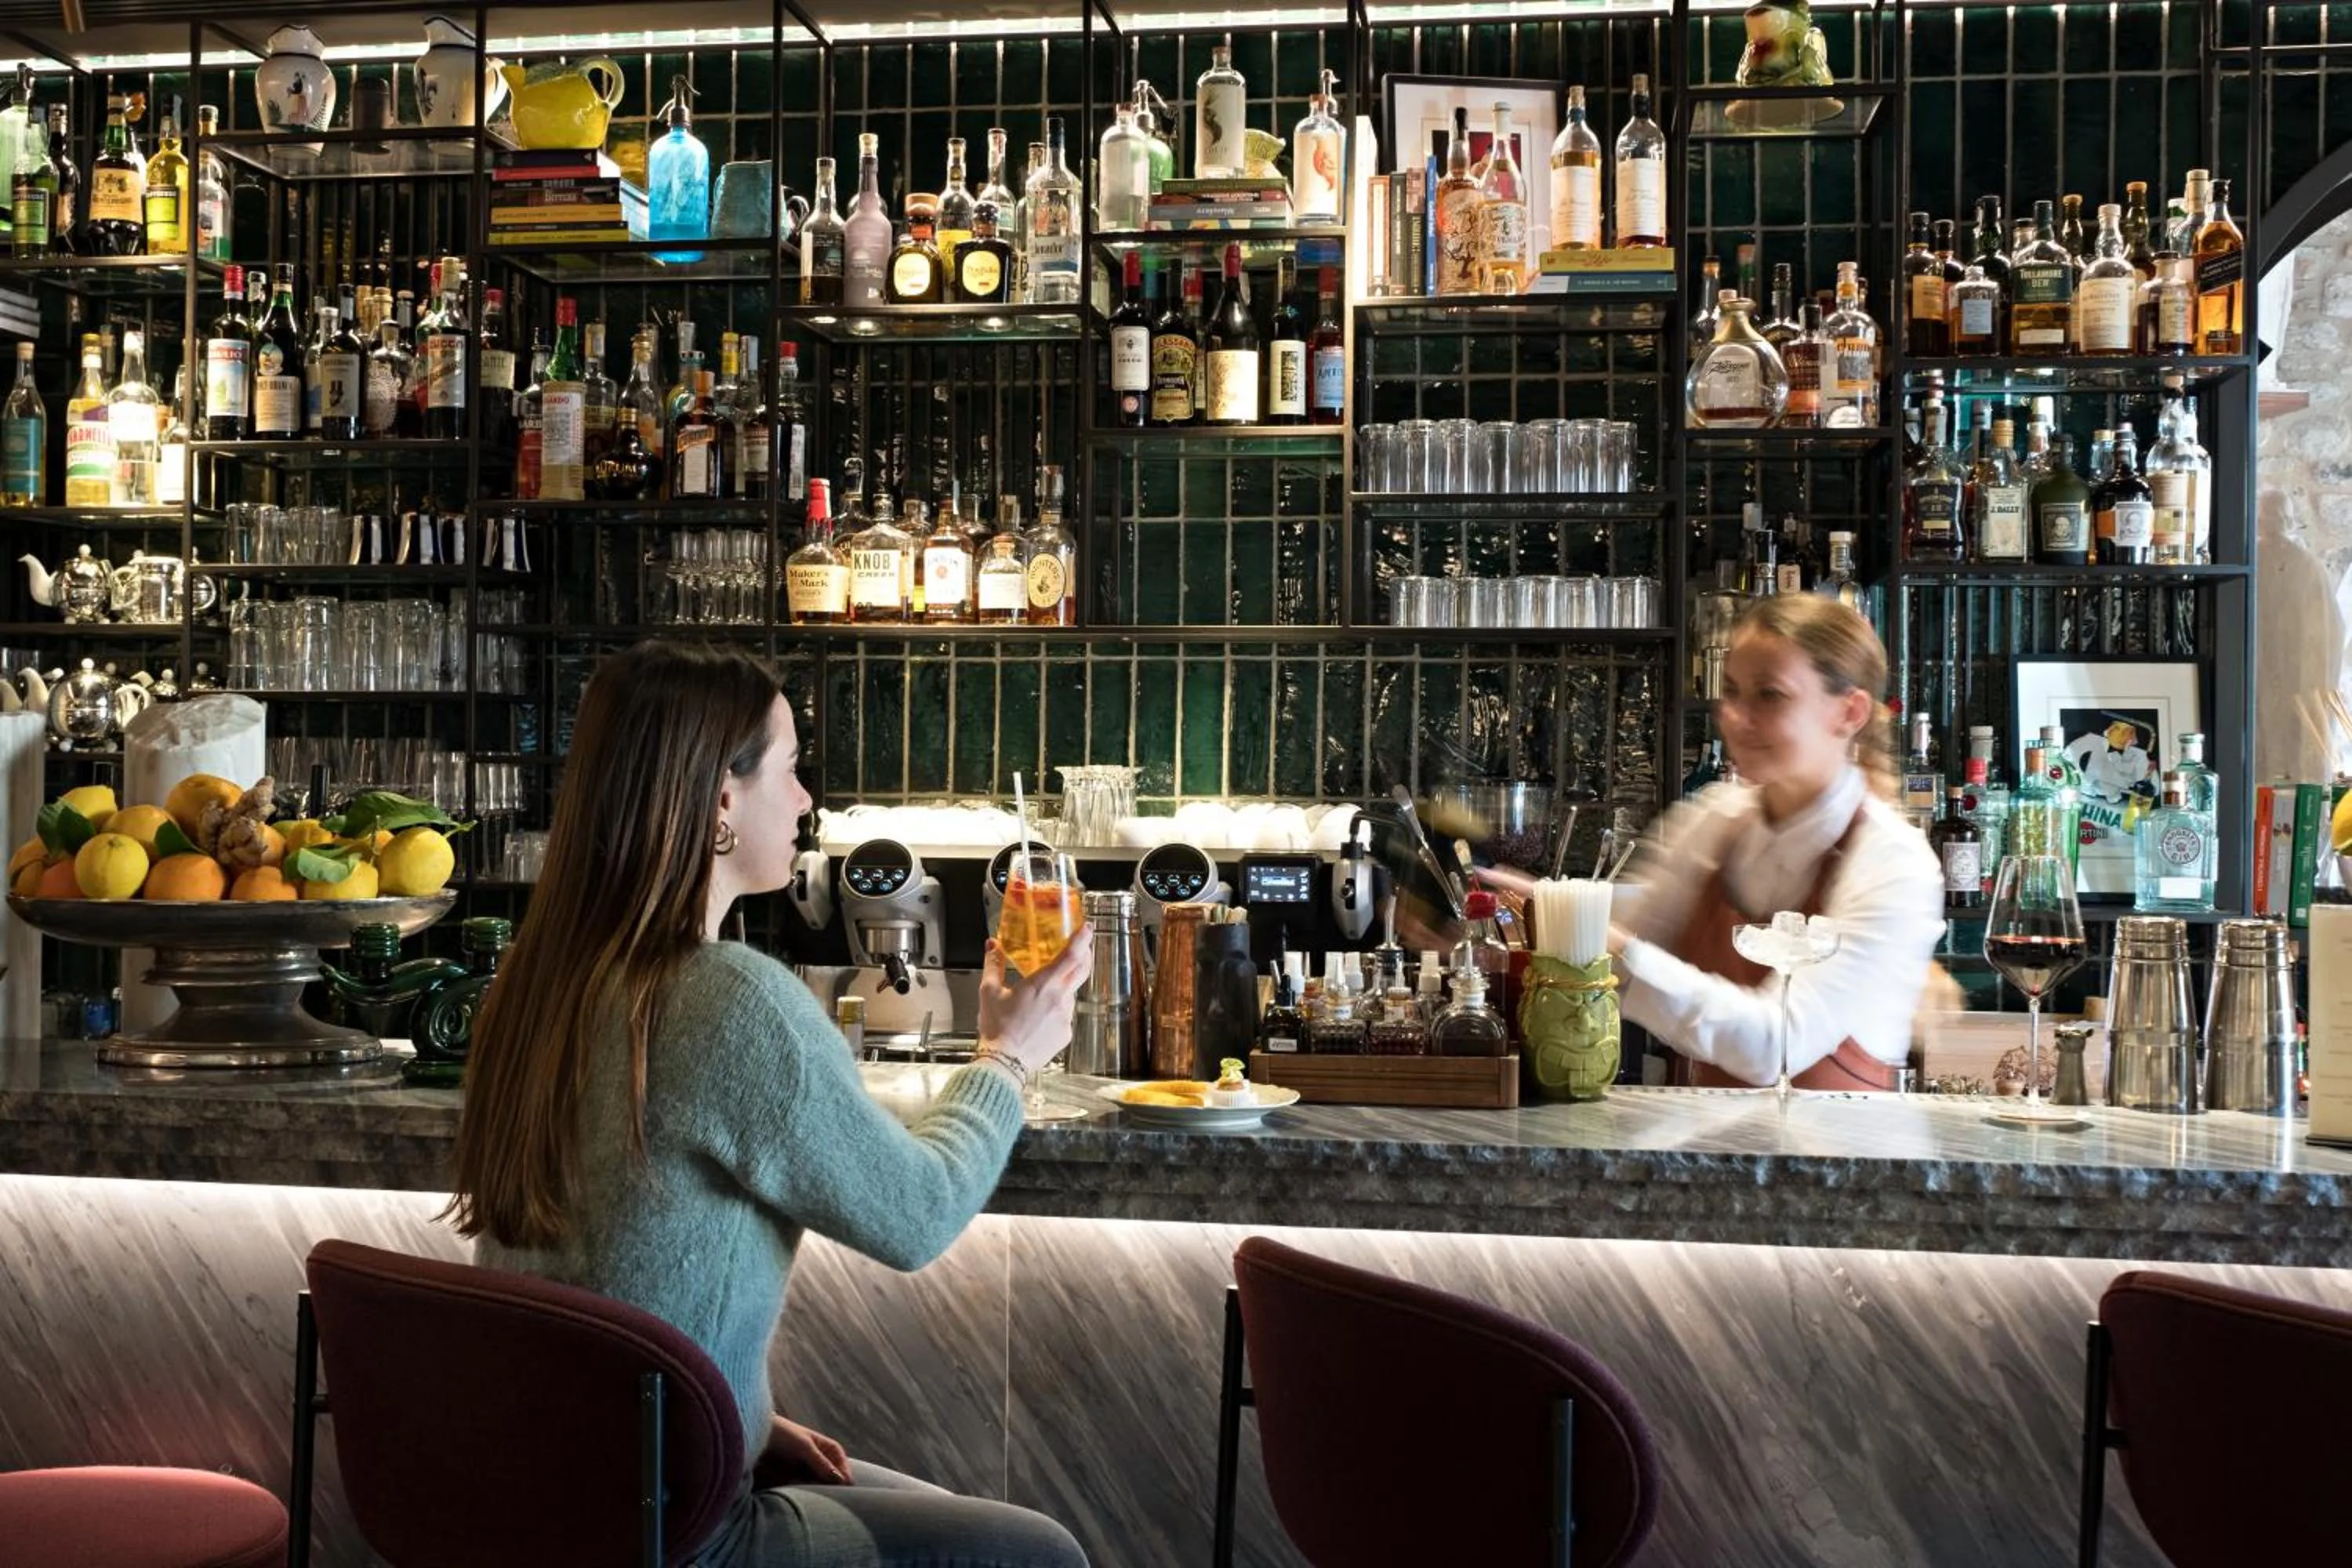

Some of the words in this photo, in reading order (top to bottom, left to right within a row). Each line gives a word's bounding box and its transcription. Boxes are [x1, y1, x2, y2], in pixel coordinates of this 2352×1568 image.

[854, 553, 891, 570] KNOB
[800, 579, 829, 587] Mark
[2082, 803, 2122, 828] HINA
[2082, 828, 2108, 839] RTINI
